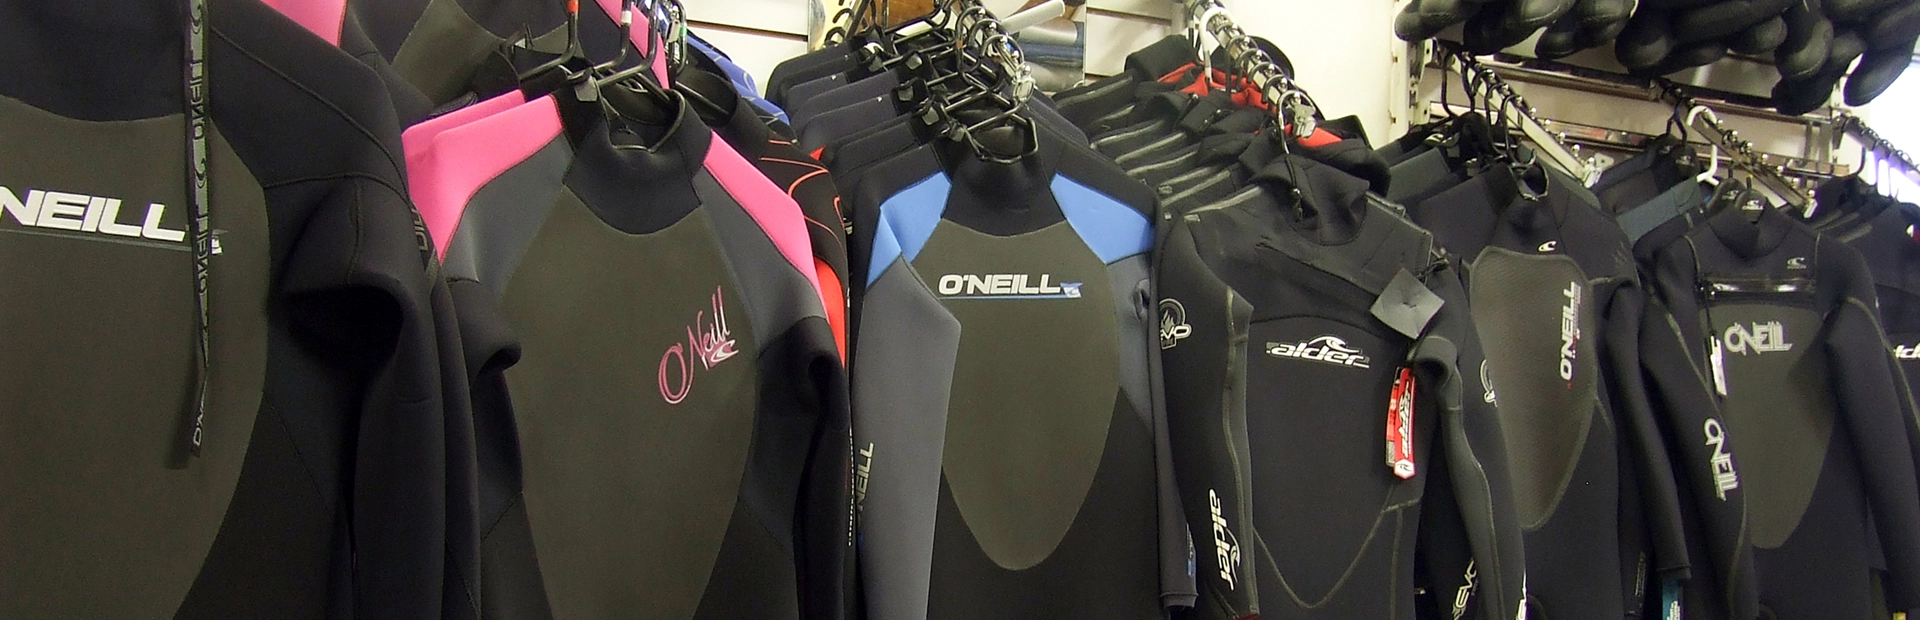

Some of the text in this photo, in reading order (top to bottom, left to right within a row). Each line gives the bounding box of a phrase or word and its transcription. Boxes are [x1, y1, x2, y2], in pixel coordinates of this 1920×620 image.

[938, 273, 1061, 295] O'NEILL
[1270, 342, 1366, 367] alder
[1560, 281, 1575, 381] O'NEILL
[1208, 488, 1235, 591] alder
